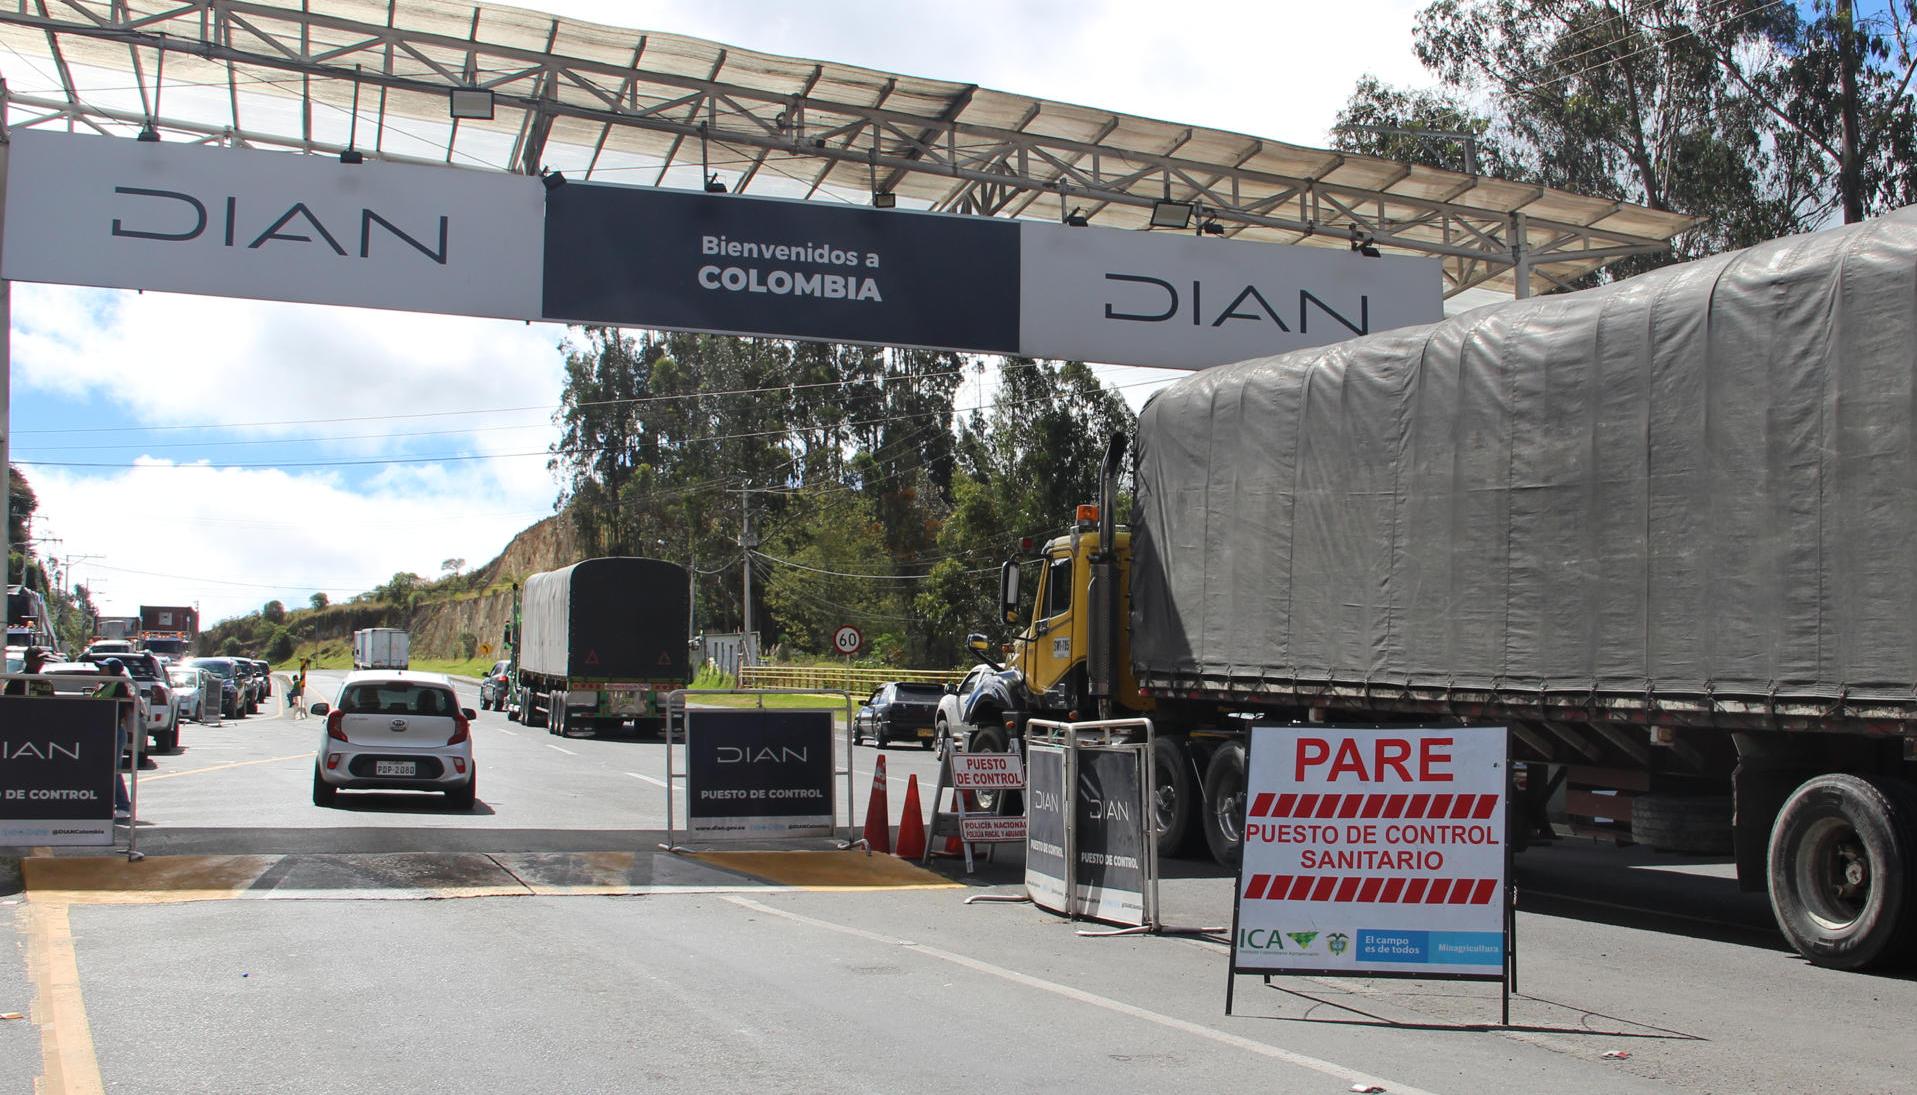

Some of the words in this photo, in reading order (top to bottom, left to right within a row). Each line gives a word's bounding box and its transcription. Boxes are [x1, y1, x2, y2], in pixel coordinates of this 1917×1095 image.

[112, 186, 449, 265] DIAN
[702, 235, 859, 267] Bienvenidos
[864, 252, 880, 268] a
[698, 264, 882, 302] COLOMBIA
[1105, 273, 1369, 337] DIAN
[839, 632, 857, 647] 60
[3, 741, 80, 759] IAN
[716, 746, 807, 763] DIAN
[966, 758, 1007, 770] PUESTO
[1295, 737, 1454, 783] PARE
[956, 773, 970, 785] DE
[973, 773, 1022, 785] CONTROL
[5, 789, 26, 800] DE
[29, 789, 98, 800] CONTROL
[701, 789, 748, 800] PUESTO
[750, 789, 766, 799] DE
[768, 788, 824, 799] CONTROL
[1035, 790, 1060, 814] DIAN
[1089, 799, 1130, 821] DIAN
[993, 821, 1027, 829] NACIONA
[1245, 823, 1339, 845] PUESTO
[1346, 825, 1378, 845] DE
[1385, 825, 1500, 845] CONTROL
[1081, 851, 1104, 865] PUESTO
[1105, 854, 1113, 866] DE
[1113, 855, 1139, 869] CONTROL
[1300, 849, 1444, 870] SANITARIO
[1239, 928, 1284, 950] ICA
[1365, 936, 1374, 944] El
[1376, 937, 1409, 947] campo
[1377, 944, 1390, 953] de
[1392, 945, 1420, 954] todos
[1438, 944, 1499, 955] Minagricultura
